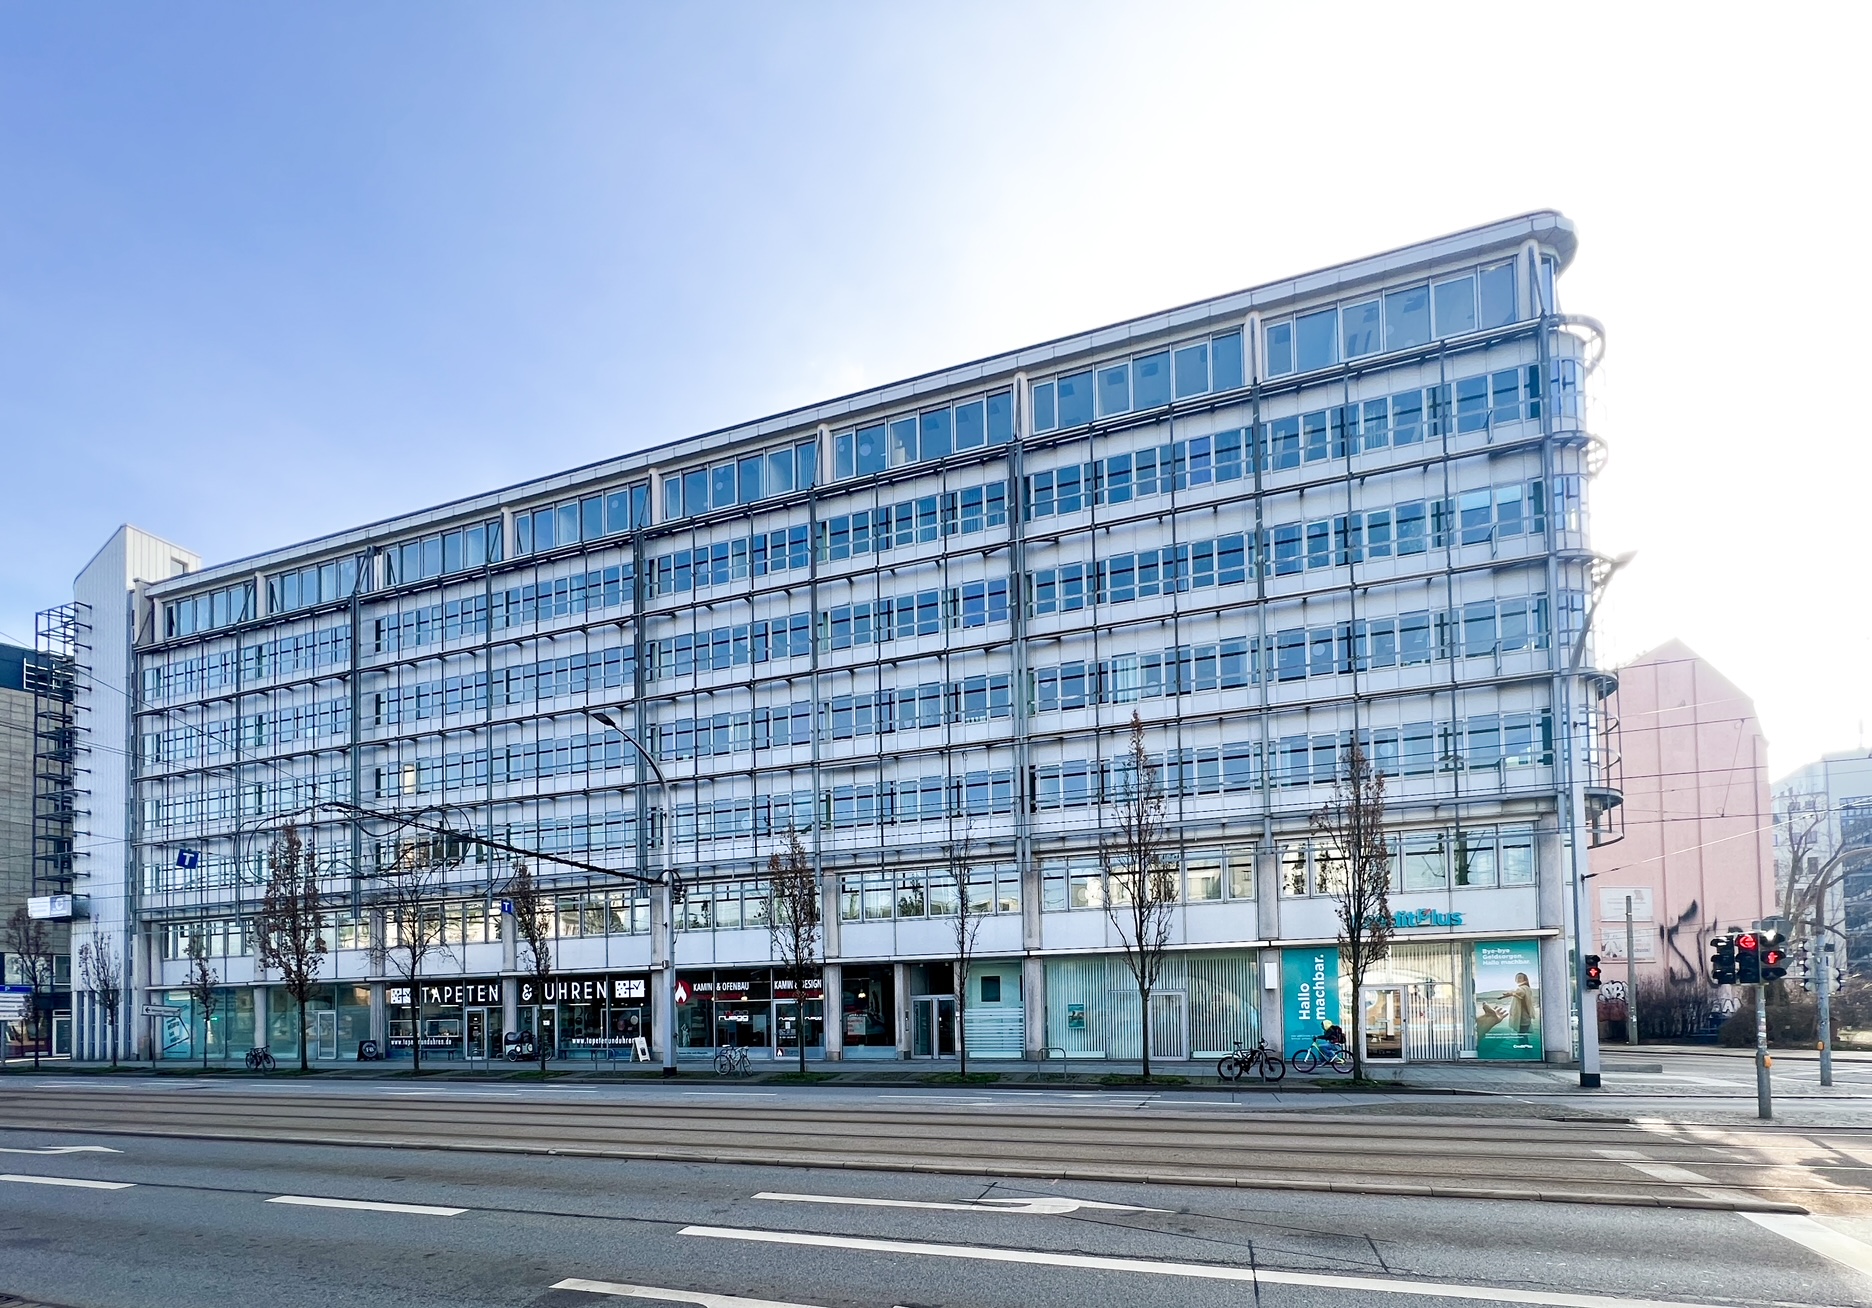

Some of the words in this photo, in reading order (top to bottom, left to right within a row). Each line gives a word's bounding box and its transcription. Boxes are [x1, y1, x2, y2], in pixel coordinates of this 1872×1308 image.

[421, 984, 499, 1004] TAPETEN
[522, 983, 533, 1001] &
[544, 981, 607, 1001] UHREN
[692, 982, 713, 992] KAMIN
[716, 982, 721, 991] &
[722, 981, 750, 991] OFENBAU
[774, 980, 794, 990] KAMIN
[1312, 954, 1325, 1020] machbar.
[1297, 982, 1311, 1020] Hallo
